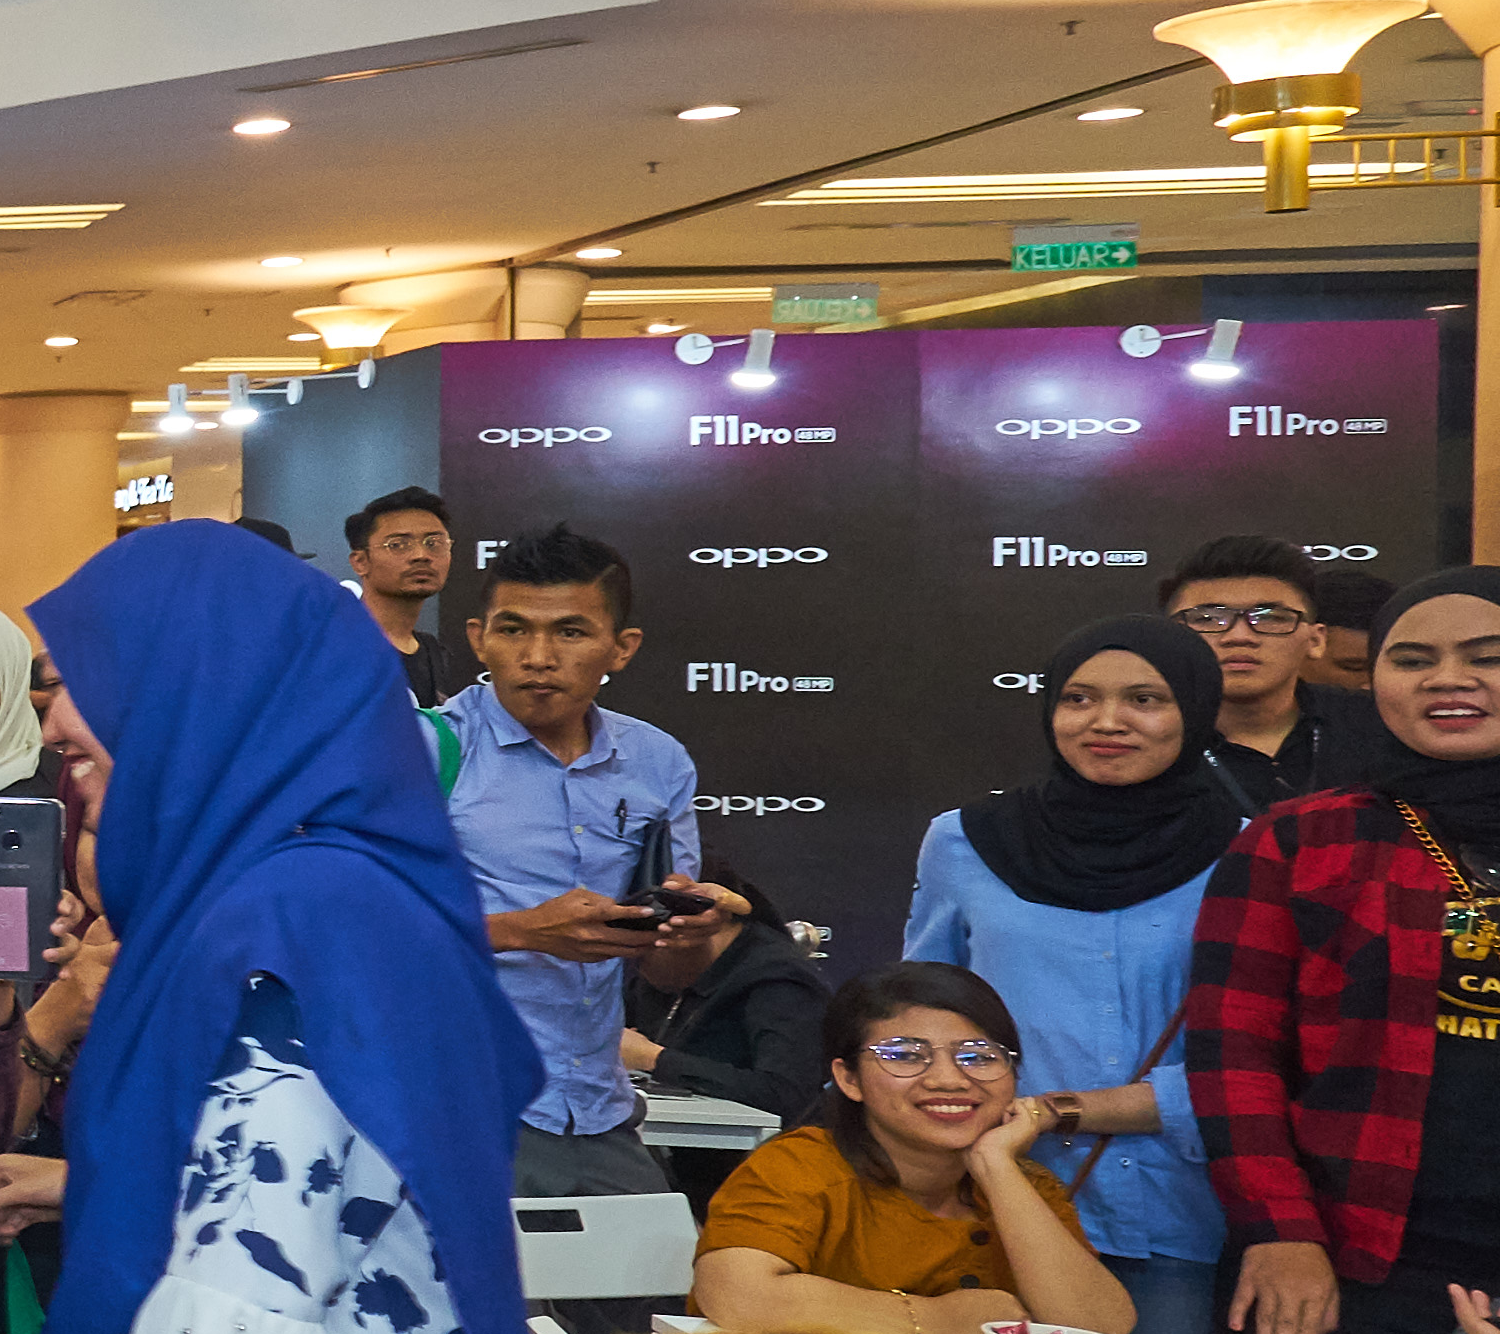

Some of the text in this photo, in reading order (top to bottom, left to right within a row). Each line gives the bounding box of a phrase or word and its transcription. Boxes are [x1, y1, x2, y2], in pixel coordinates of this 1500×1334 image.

[1015, 245, 1108, 268] KELUAR
[478, 426, 613, 448] oppo
[995, 417, 1142, 440] oppo
[689, 546, 829, 568] oppo
[693, 795, 826, 816] oppo
